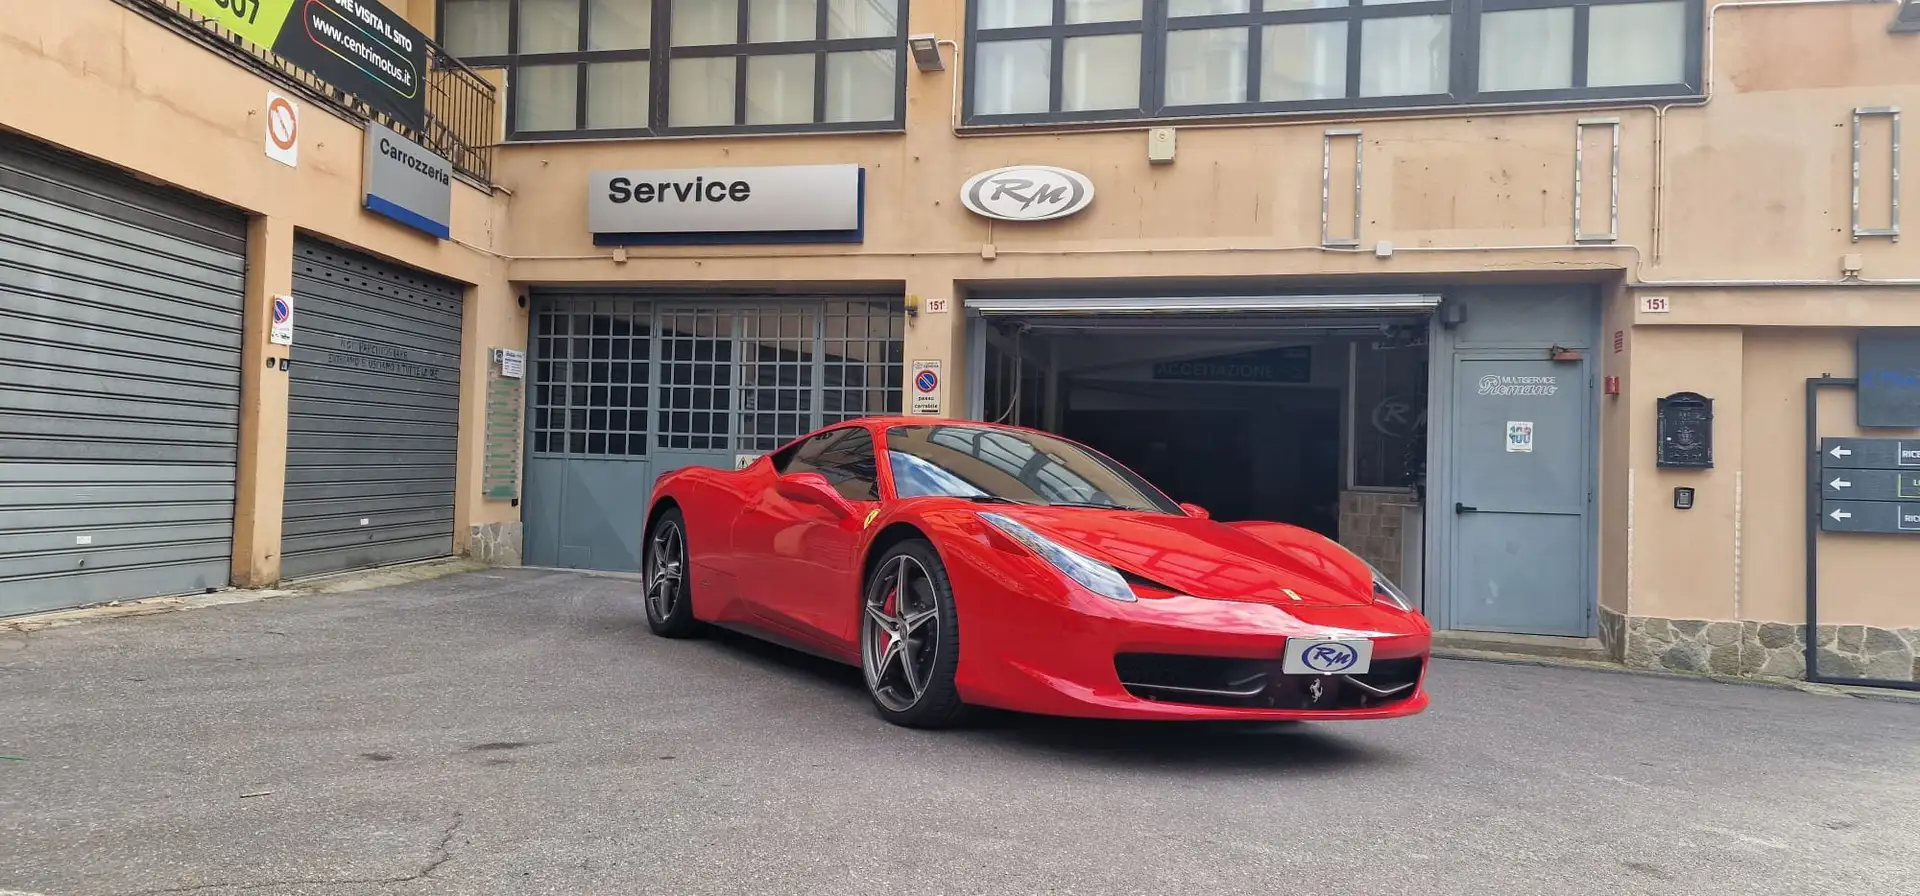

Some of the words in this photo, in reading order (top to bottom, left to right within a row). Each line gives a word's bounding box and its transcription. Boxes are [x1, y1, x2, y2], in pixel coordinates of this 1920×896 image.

[354, 2, 384, 34] VISITA
[384, 23, 393, 40] IL
[393, 29, 412, 52] SITO
[312, 14, 412, 86] www.centrimotus.it
[380, 137, 449, 186] Carrozzeria
[608, 176, 751, 204] Service
[988, 178, 1068, 212] RM
[1157, 362, 1275, 379] ACCETTAZIONE
[1502, 376, 1557, 384] MULTISERVICE
[1477, 374, 1559, 396] Romano
[1313, 646, 1351, 668] RM
